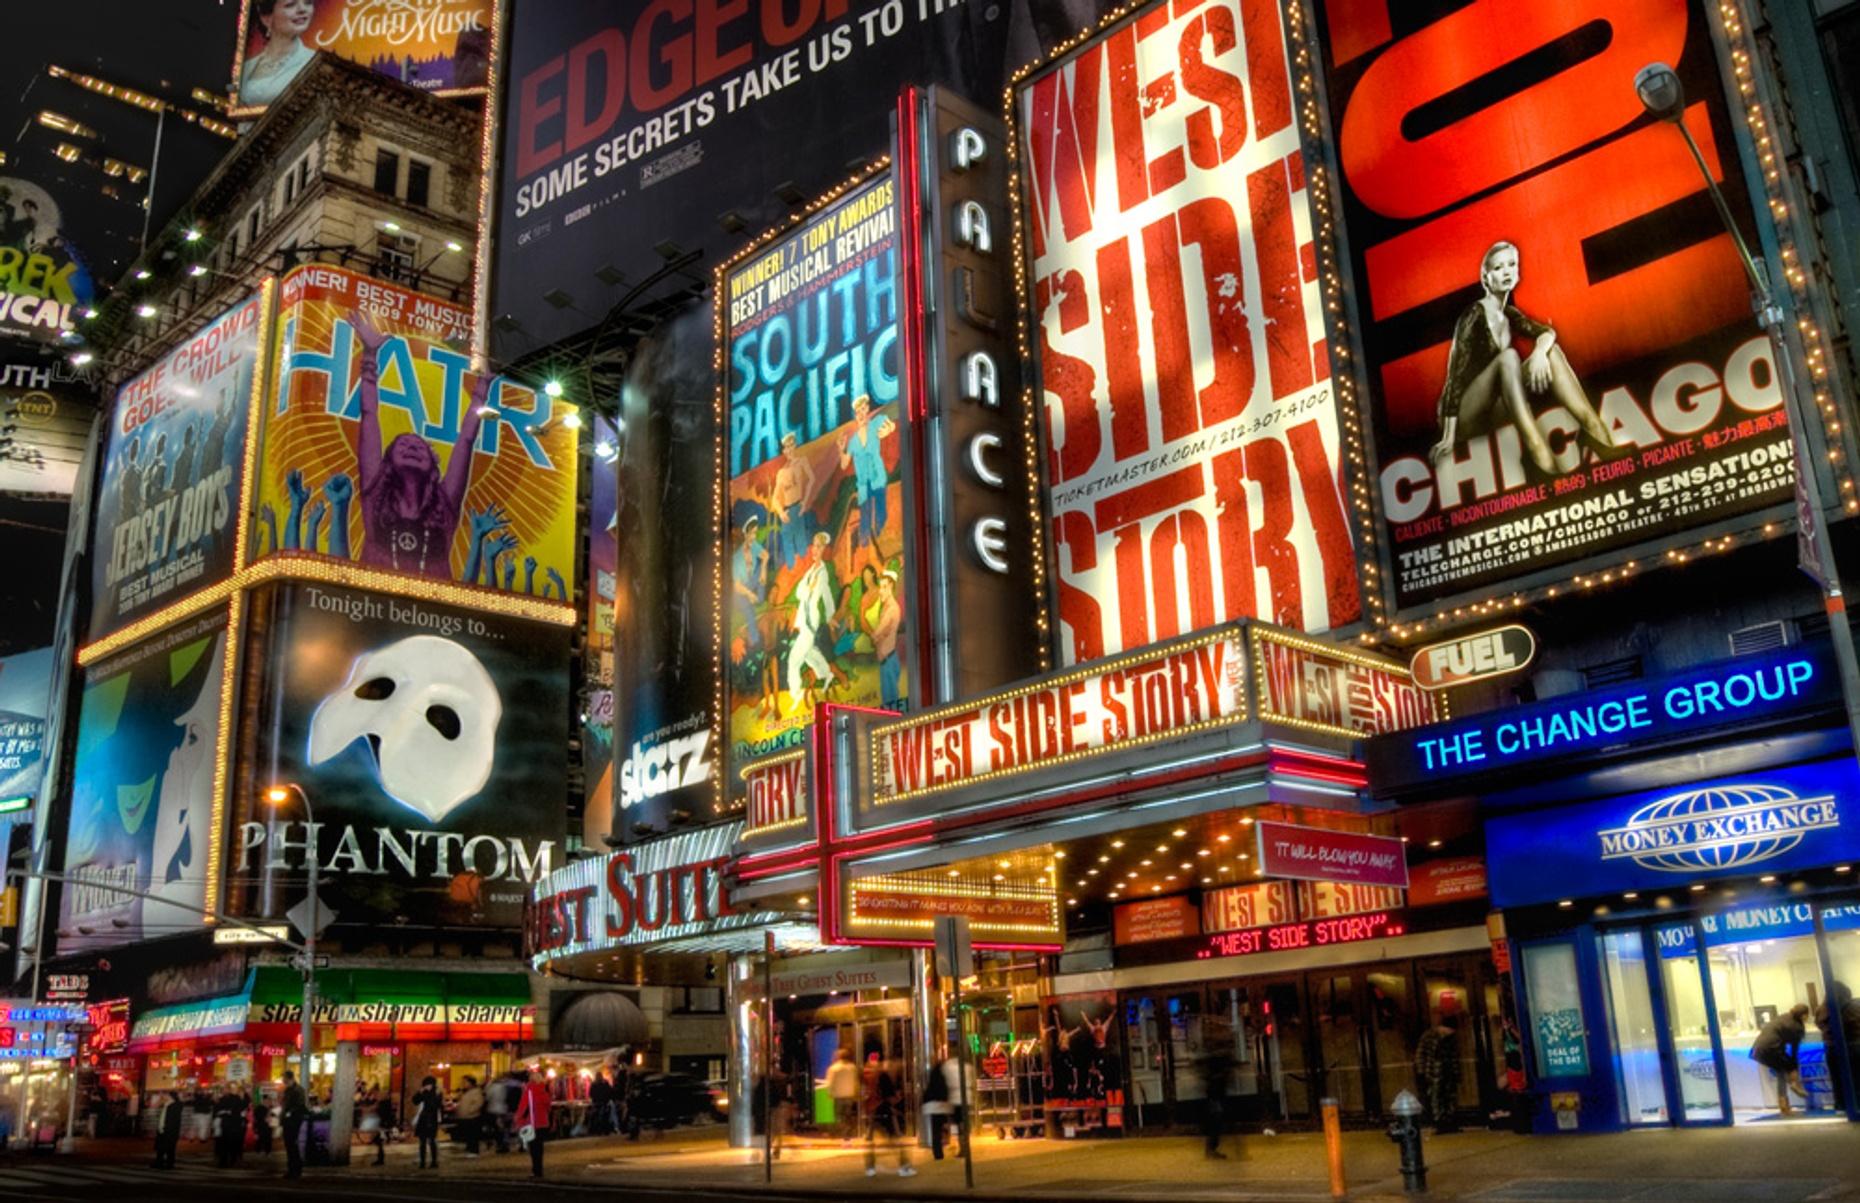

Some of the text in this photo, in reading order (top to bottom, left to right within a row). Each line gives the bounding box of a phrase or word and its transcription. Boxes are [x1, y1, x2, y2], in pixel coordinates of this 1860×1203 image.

[316, 5, 486, 46] NIGHT MUSIC
[515, 153, 589, 218] SOME
[594, 90, 715, 178] SECRETS
[721, 48, 801, 114] TAKE
[808, 23, 853, 73] US
[858, 0, 904, 46] TO
[516, 0, 753, 182] EDGE
[1029, 0, 1293, 260] WEST
[731, 248, 784, 300] WINNER!
[801, 215, 837, 256] TONY
[838, 180, 894, 235] AWARDS
[282, 269, 348, 298] WINNER!
[356, 281, 408, 312] BEST
[359, 299, 444, 334] 2009 TONY
[731, 285, 765, 327] BEST
[768, 251, 833, 305] MUSICAL
[731, 248, 896, 405] SOUTH
[1035, 148, 1333, 488] SIDE
[172, 300, 259, 377] CROWD
[277, 318, 555, 471] HAIR
[731, 323, 898, 479] PACIFIC
[1379, 336, 1784, 524] CHICAGO
[177, 465, 233, 545] BOYS
[1053, 438, 1206, 508] TICKETMASTER.COM
[1394, 514, 1445, 543] CALIENTE
[1592, 457, 1636, 485] FEURIG
[1642, 439, 1696, 469] PICANTE
[1399, 438, 1794, 570] THE INTERNATIONAL SENSATION!
[106, 497, 178, 588] JERSEY
[1052, 418, 1363, 664] STORY
[306, 587, 384, 622] Tonight
[389, 605, 462, 635] belongs
[1260, 640, 1345, 729] WEST
[1427, 632, 1516, 683] FUEL
[889, 710, 981, 797] WEST
[988, 683, 1089, 769] SIDE
[1100, 641, 1226, 745] STORY
[1417, 660, 1814, 770] THE CHANGE GROUP
[620, 729, 712, 810] starz
[238, 820, 557, 884] PHANTOM
[1601, 801, 1839, 855] MONEY EXCHANGE
[797, 974, 833, 990] GUEST
[834, 970, 877, 988] SUITES
[1269, 925, 1309, 950] SIDE
[261, 1003, 341, 1023] sbaro
[361, 1000, 437, 1022] sbarro
[454, 1003, 522, 1023] sbarro
